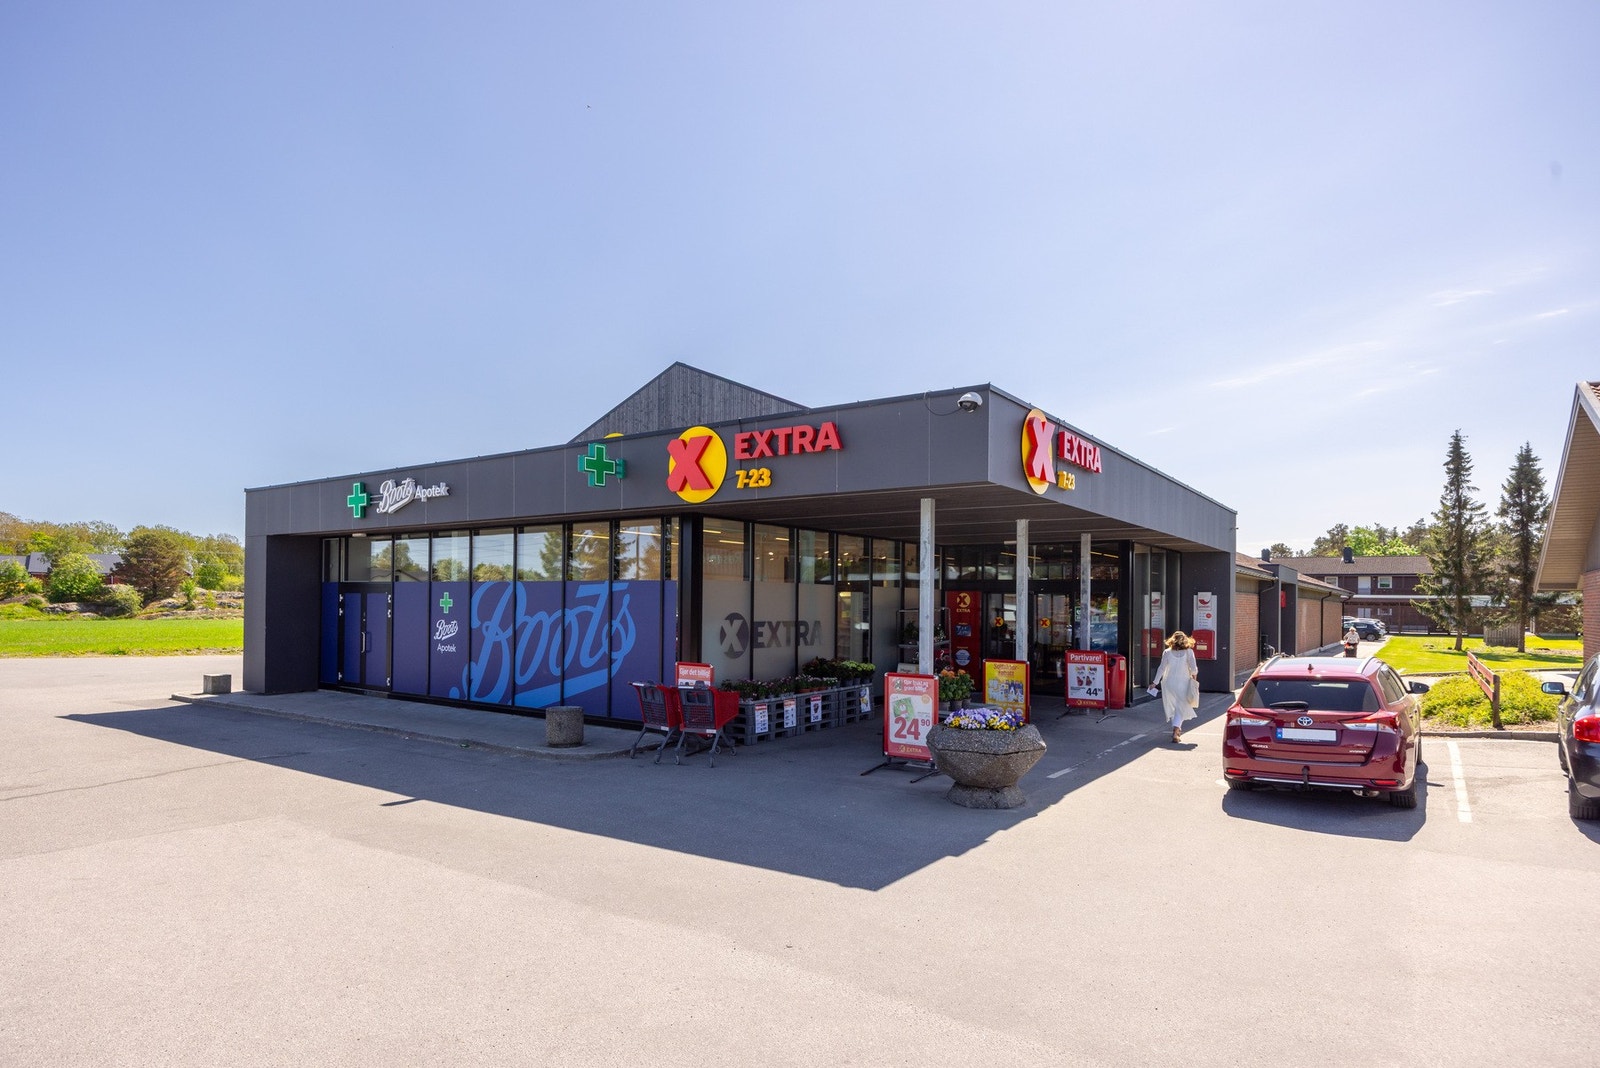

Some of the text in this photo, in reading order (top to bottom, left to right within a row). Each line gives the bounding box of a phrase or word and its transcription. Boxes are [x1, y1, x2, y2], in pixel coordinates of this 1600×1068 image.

[734, 421, 844, 460] EXTRA
[1058, 431, 1102, 474] EXTRA
[735, 467, 772, 489] 7-23
[1057, 470, 1076, 490] 7-23
[376, 477, 450, 514] Boots Apotek
[433, 619, 459, 641] Boots
[753, 620, 823, 649] EXTRA
[436, 643, 457, 654] Apotek
[449, 581, 636, 707] Boots
[1070, 653, 1102, 662] Partivare!
[1086, 687, 1098, 697] 44
[894, 716, 931, 741] 24 90
